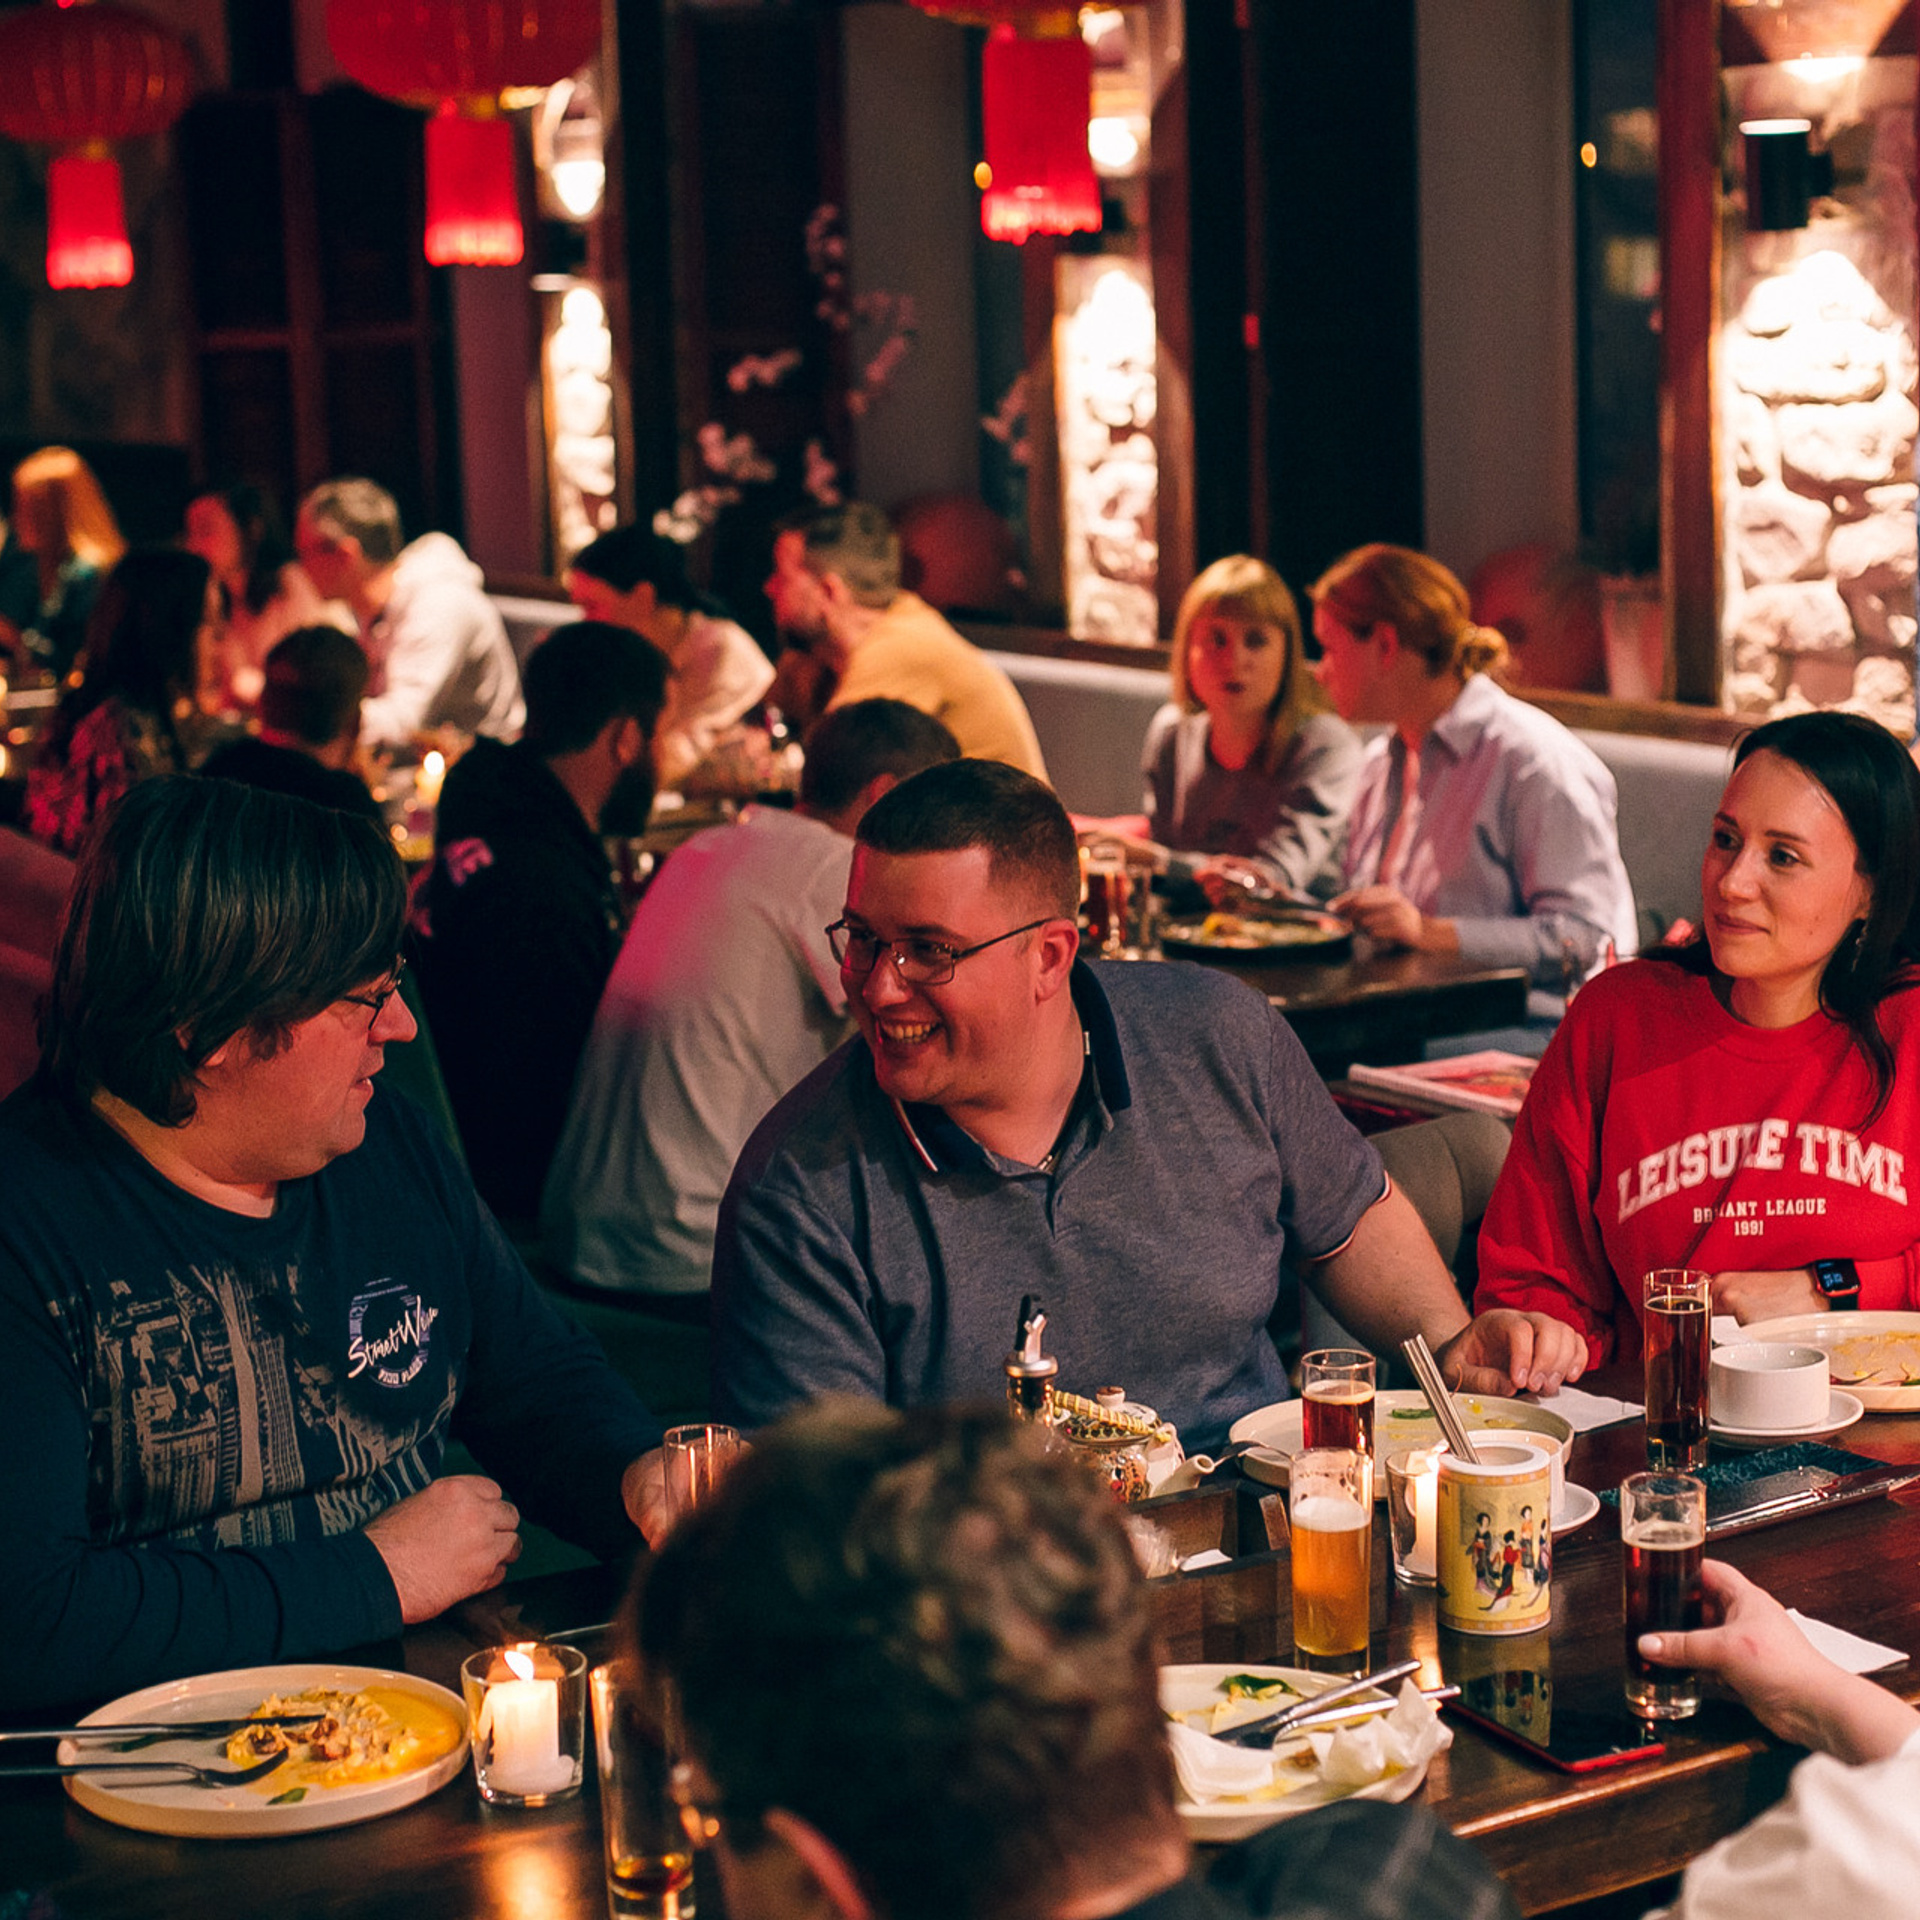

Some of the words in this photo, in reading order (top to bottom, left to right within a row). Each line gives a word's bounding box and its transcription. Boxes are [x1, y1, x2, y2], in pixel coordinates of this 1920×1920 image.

[1794, 1121, 1908, 1206] TIME
[1765, 1197, 1827, 1216] LEAGUE
[1733, 1220, 1765, 1236] 1991
